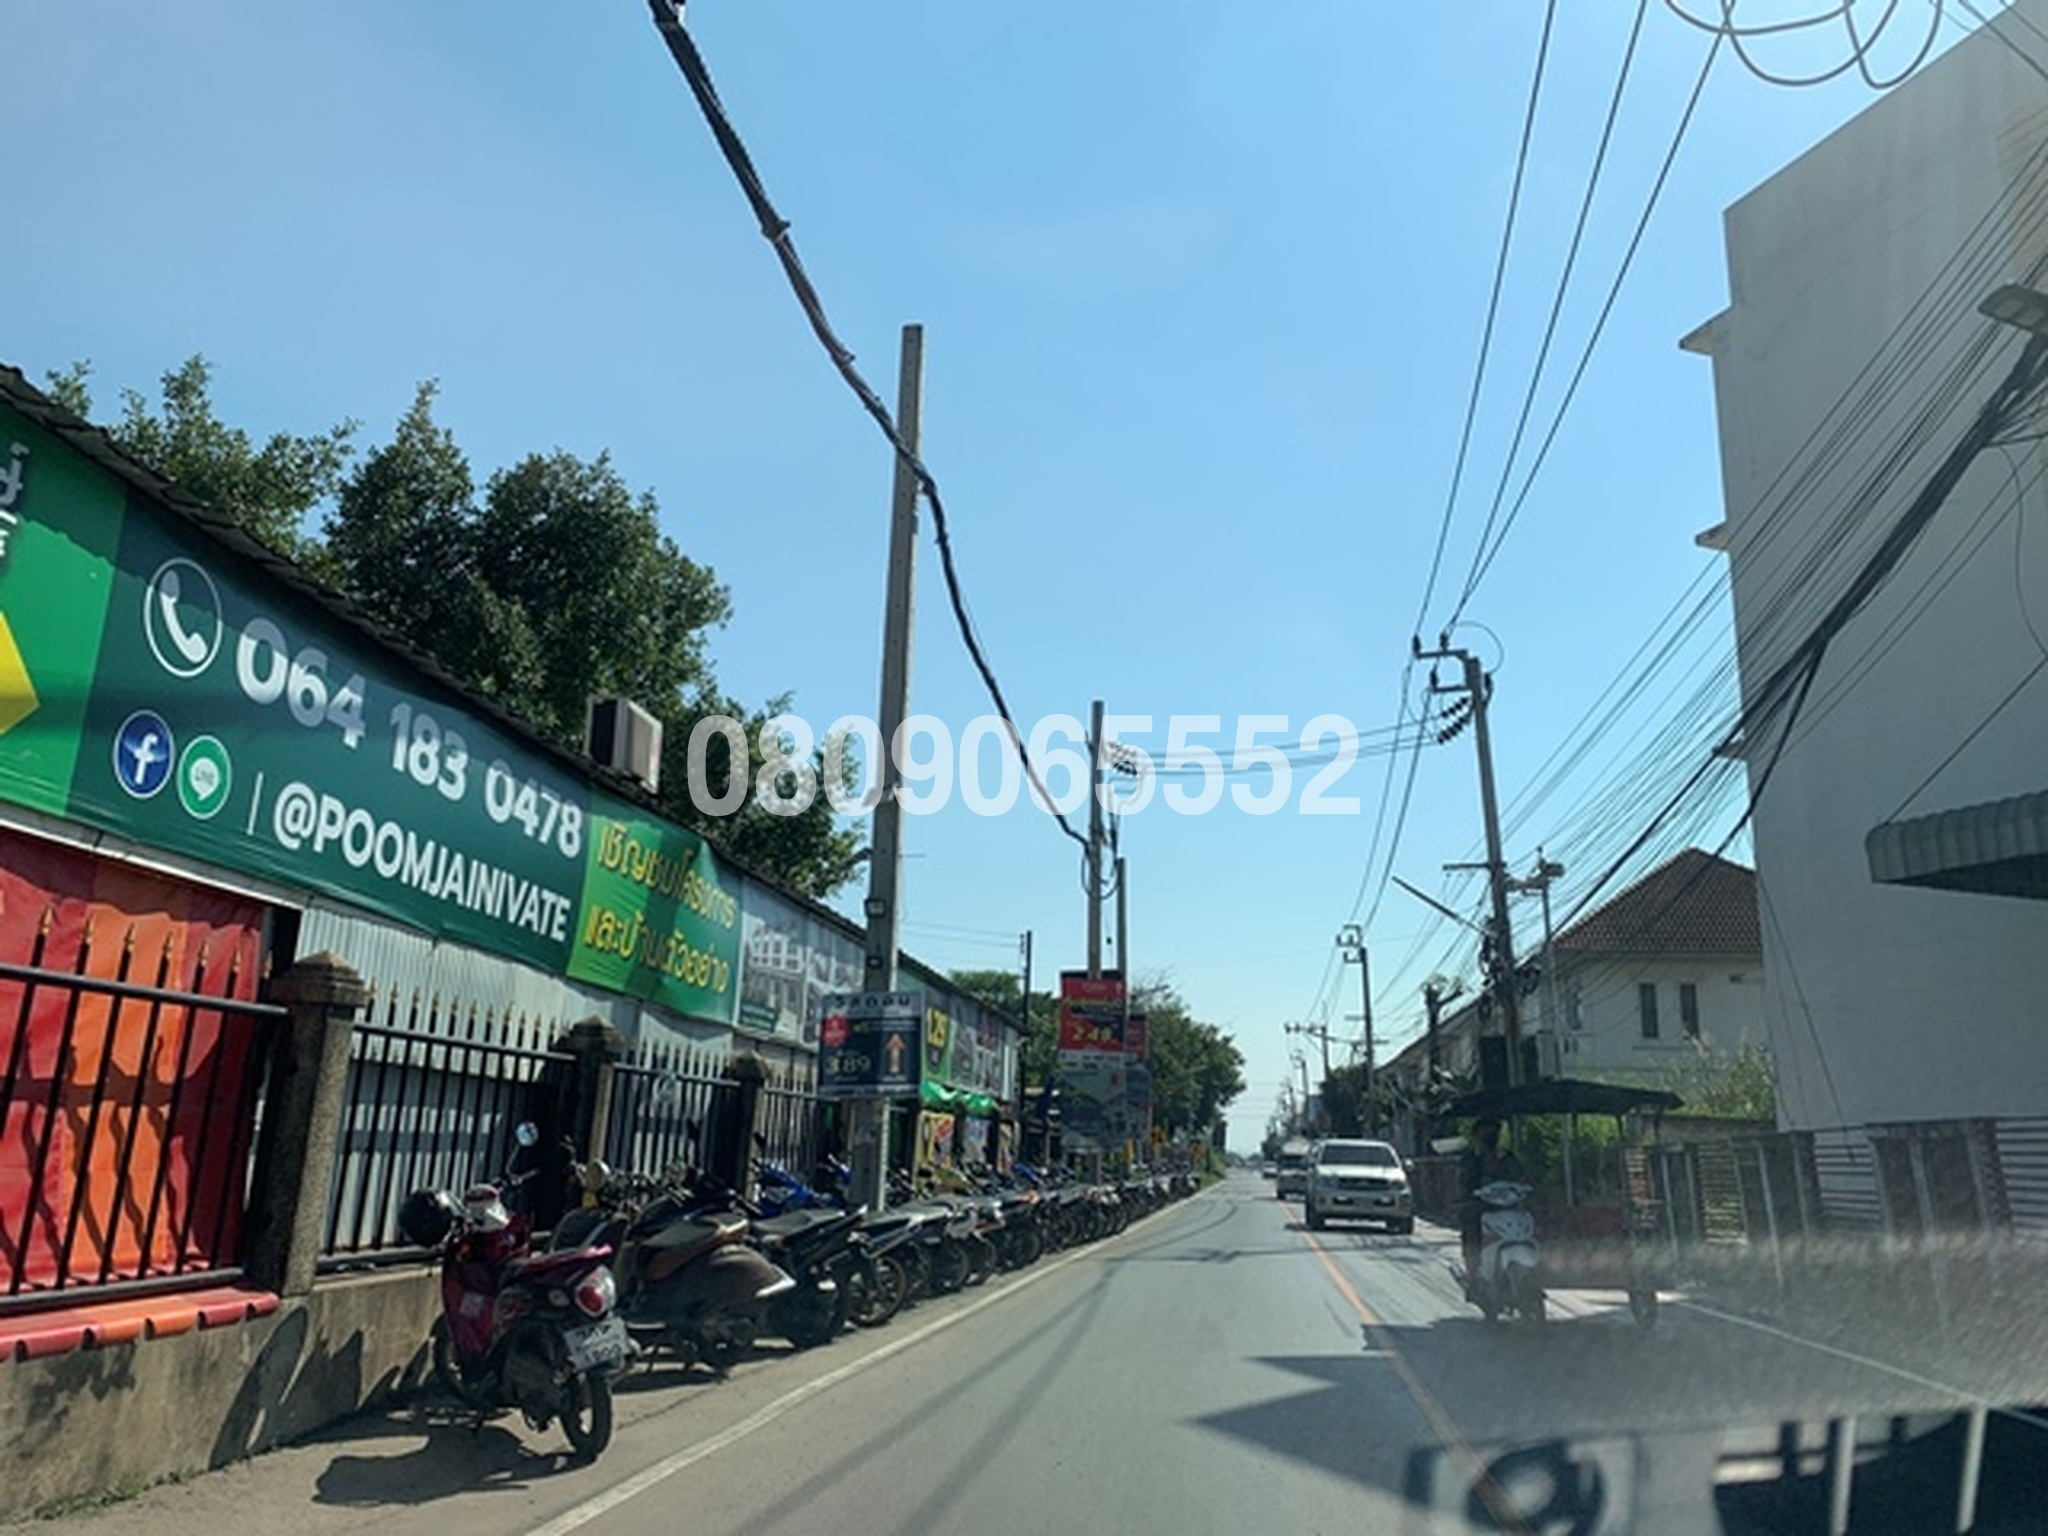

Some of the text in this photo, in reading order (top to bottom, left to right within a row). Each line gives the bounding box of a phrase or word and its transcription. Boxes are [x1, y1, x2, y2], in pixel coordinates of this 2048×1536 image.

[236, 617, 584, 859] 064 183 0478
[272, 782, 572, 944] @POOMJAINIVATE
